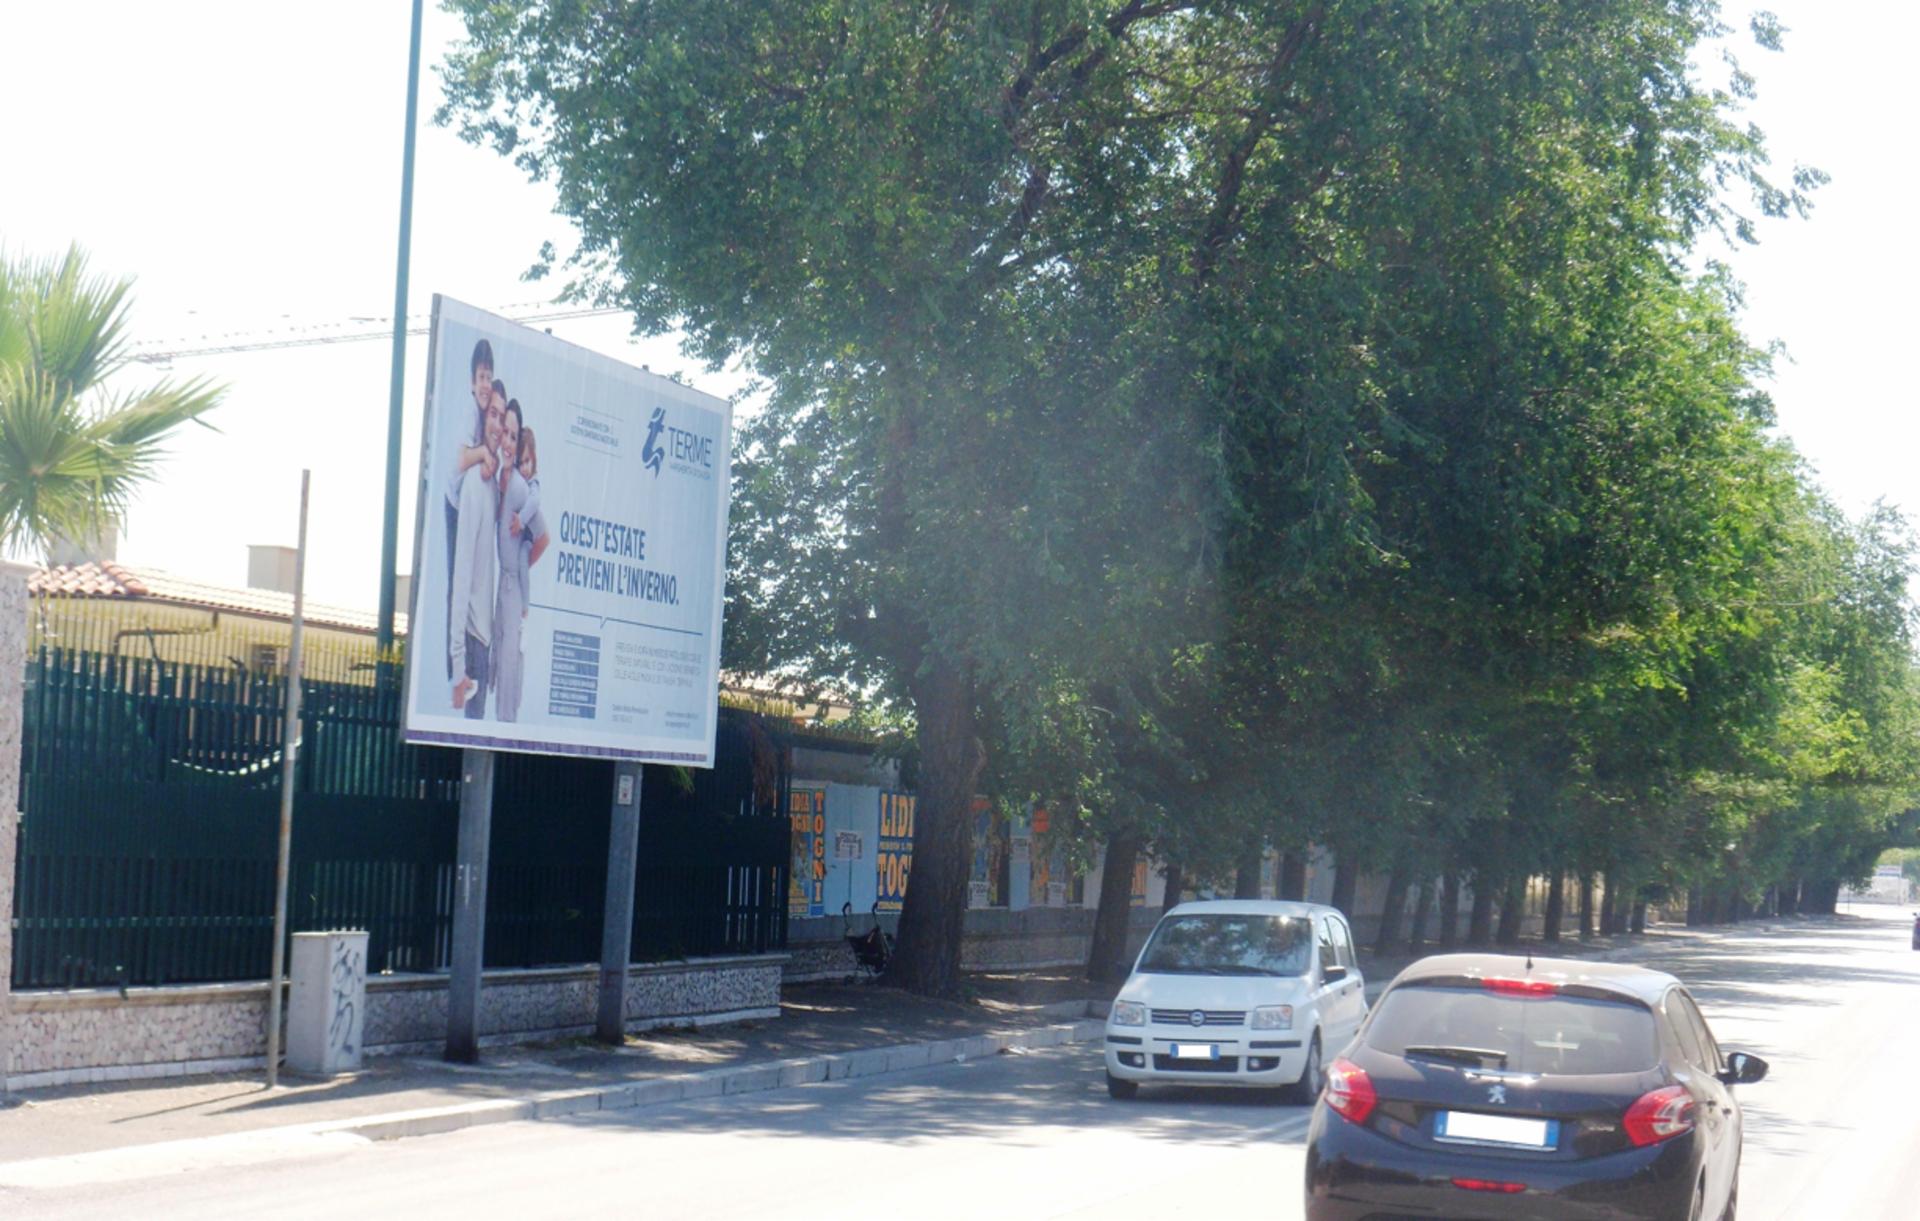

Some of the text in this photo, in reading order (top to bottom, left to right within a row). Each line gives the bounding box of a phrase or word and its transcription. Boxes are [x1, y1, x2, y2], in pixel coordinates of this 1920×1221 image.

[668, 426, 713, 469] TERME
[560, 510, 647, 561] QUEST'ESTATE
[557, 551, 680, 606] PREVIENI L'INVERNO.
[880, 793, 916, 838] LIDI
[812, 790, 826, 902] TOGNI
[877, 853, 913, 898] TOG
